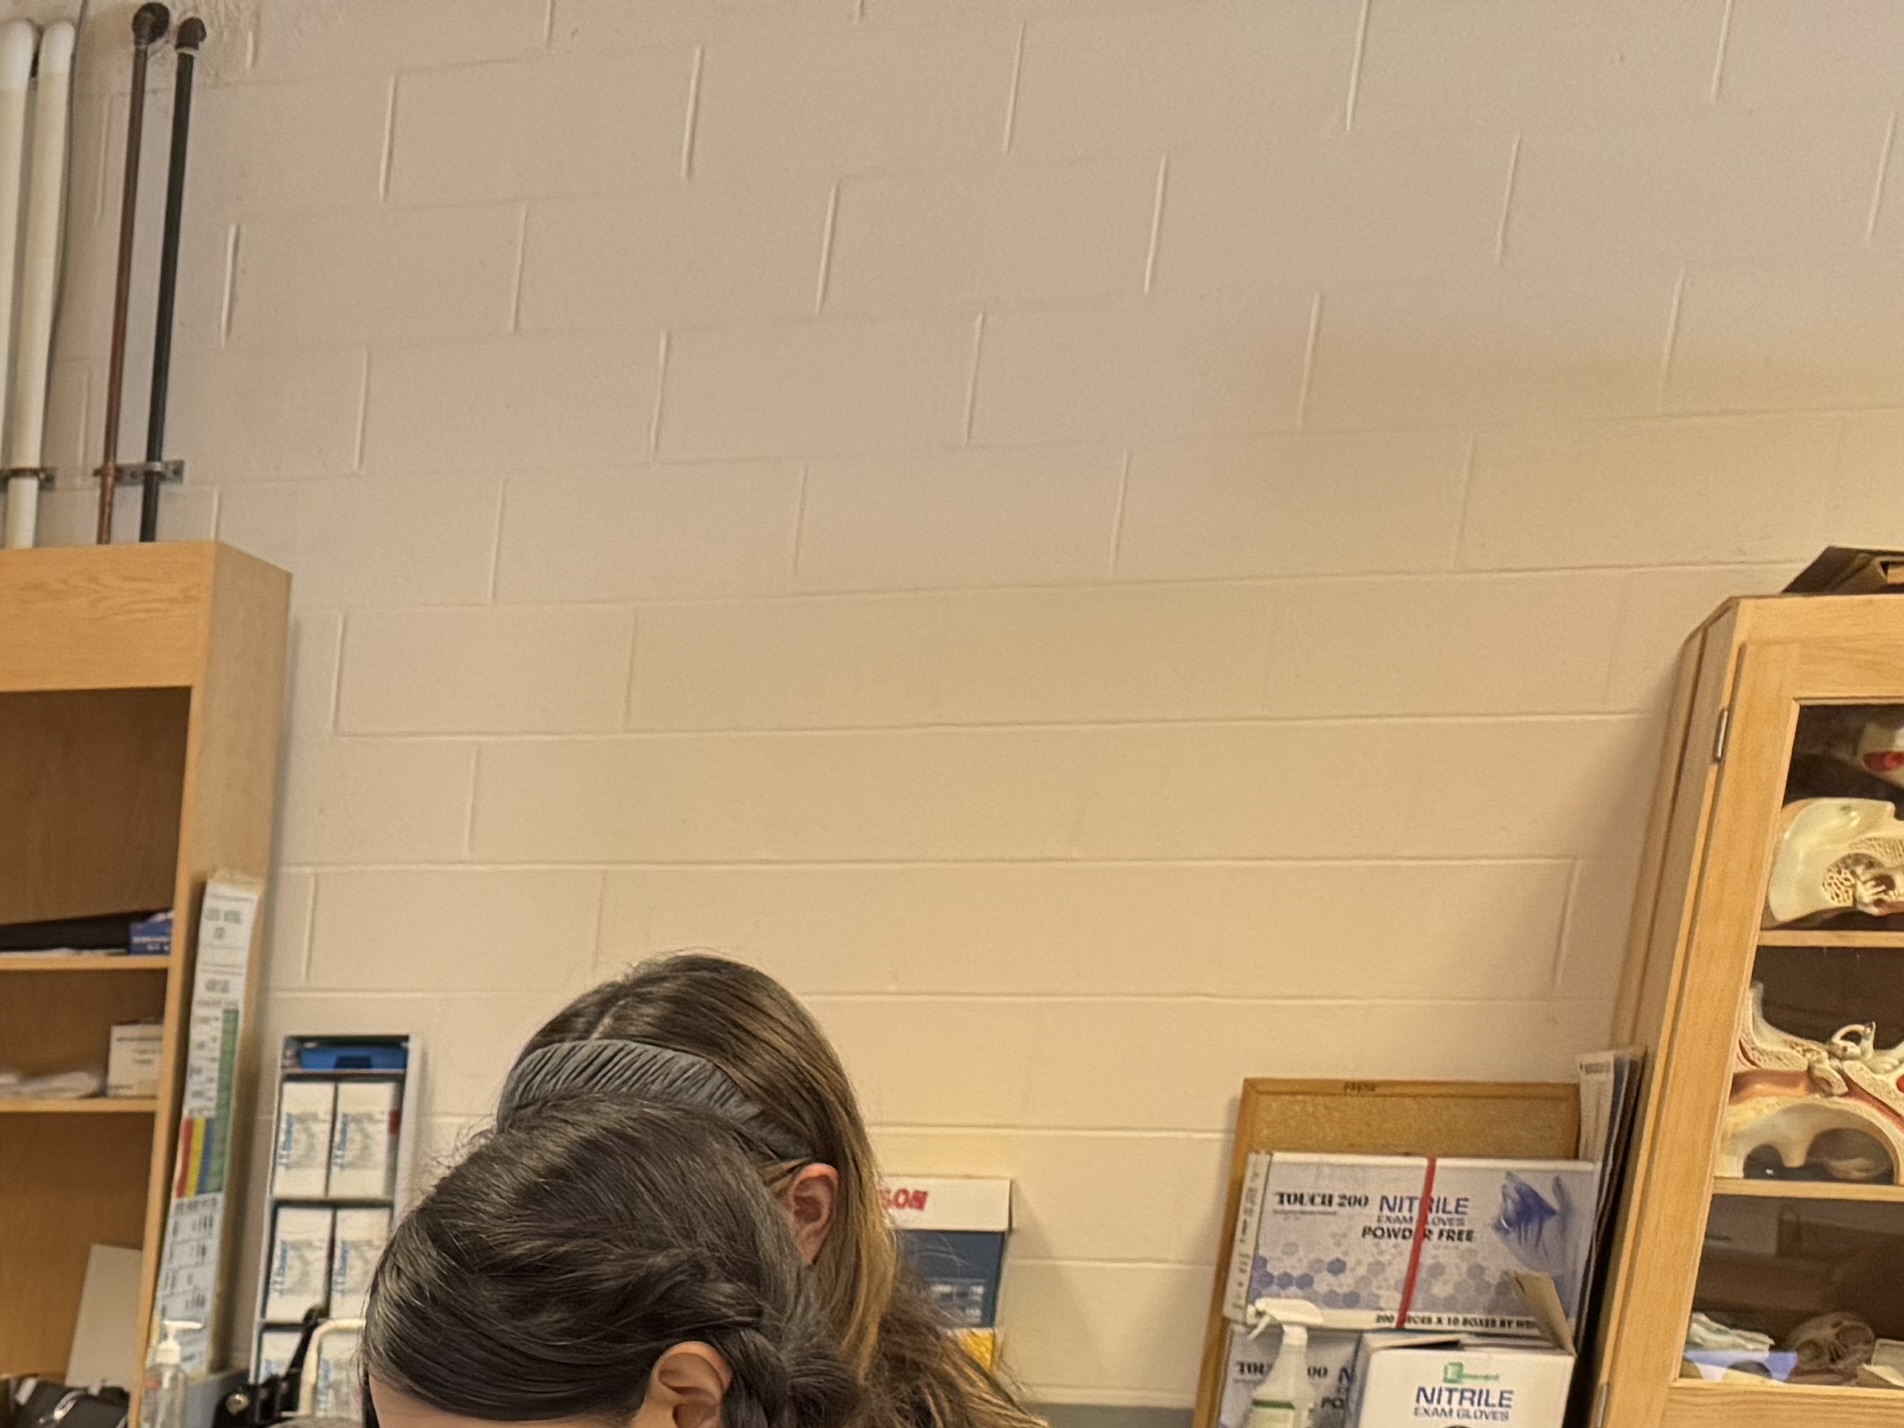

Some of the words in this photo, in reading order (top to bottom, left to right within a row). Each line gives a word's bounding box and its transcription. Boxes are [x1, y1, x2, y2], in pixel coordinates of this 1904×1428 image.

[1273, 1192, 1333, 1208] TOUCH
[1336, 1194, 1369, 1208] 200
[1424, 1216, 1467, 1228] LOVES
[1361, 1227, 1434, 1242] POWDR
[1437, 1228, 1475, 1242] FREE
[1307, 1366, 1328, 1378] 00
[1415, 1386, 1515, 1409] NITRILE
[1413, 1407, 1454, 1419] EXAM
[1457, 1408, 1510, 1422] GLOVES
